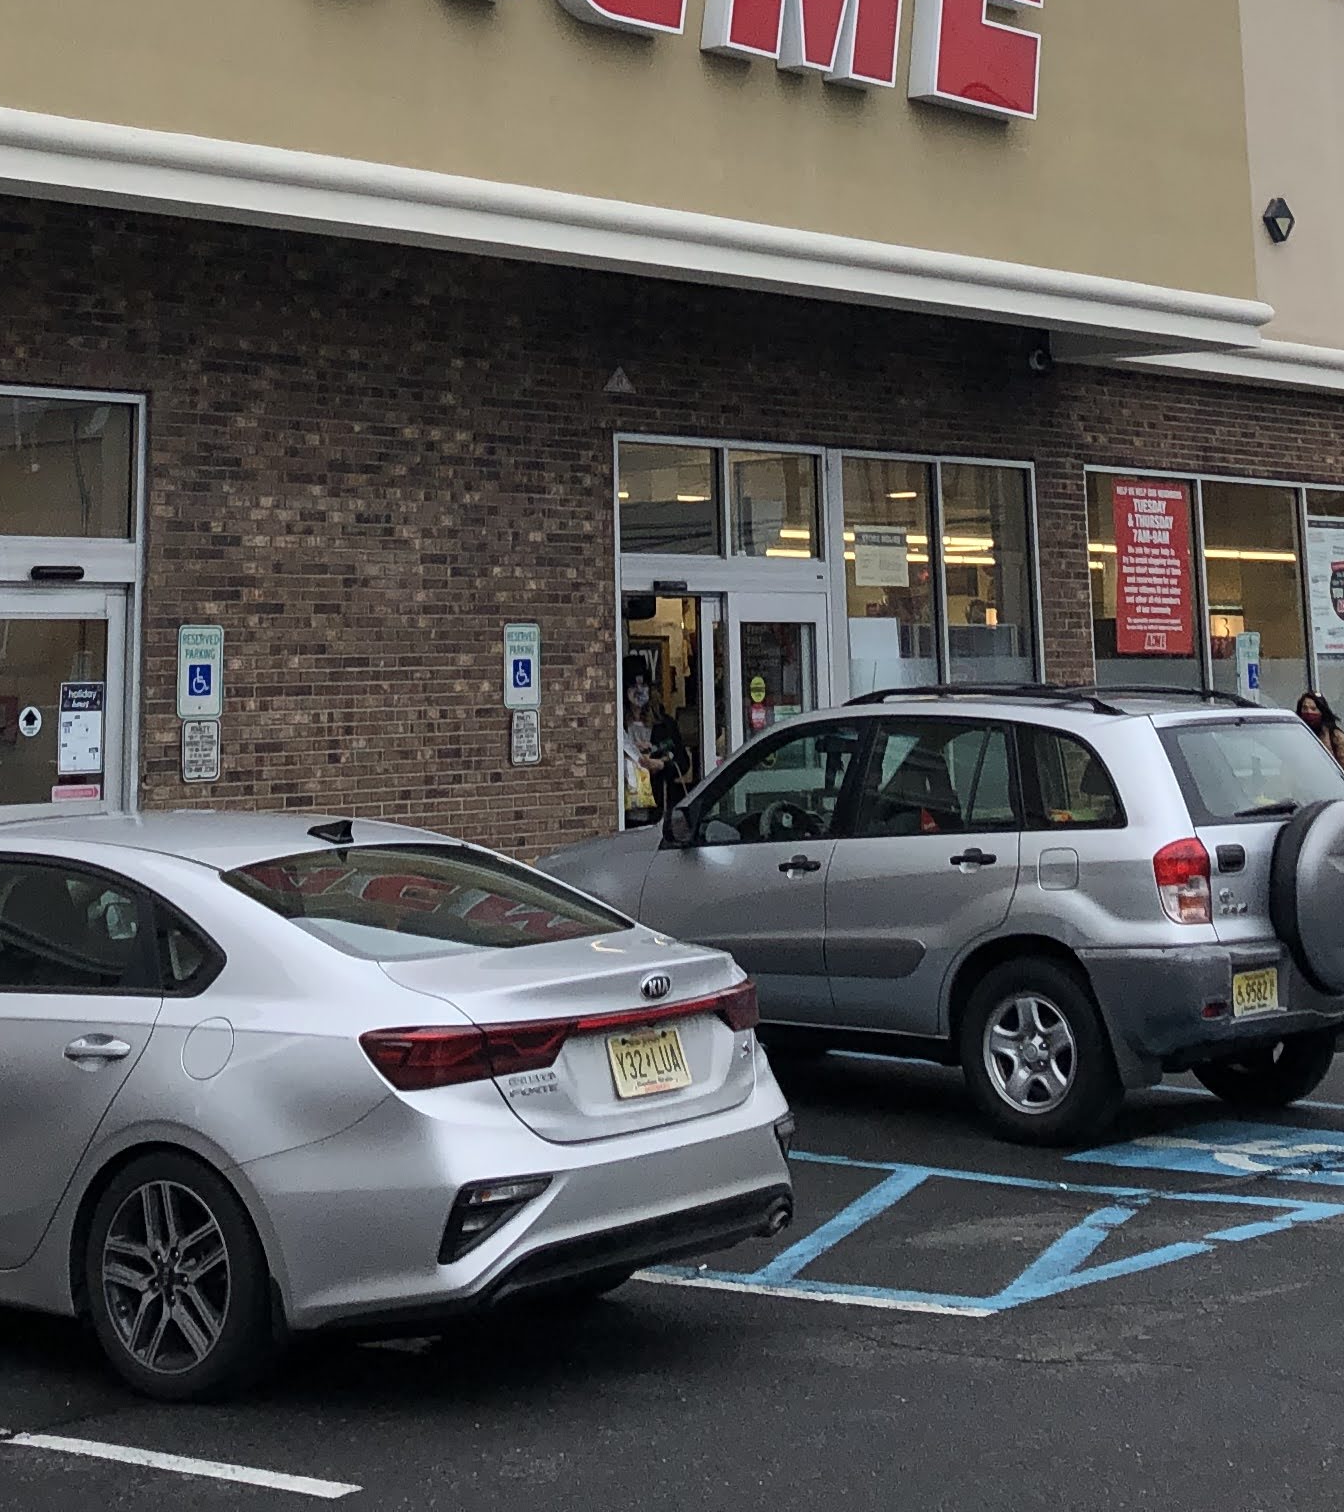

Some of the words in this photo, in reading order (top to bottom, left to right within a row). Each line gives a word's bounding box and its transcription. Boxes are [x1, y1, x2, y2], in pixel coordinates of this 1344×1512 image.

[1133, 498, 1166, 514] TUESDAY
[1134, 514, 1173, 529] THURSDAY
[182, 633, 220, 646] RESERVED
[507, 631, 536, 642] RESERVED
[185, 647, 216, 660] PARKING
[68, 689, 98, 700] holiday
[649, 978, 668, 996] KIA
